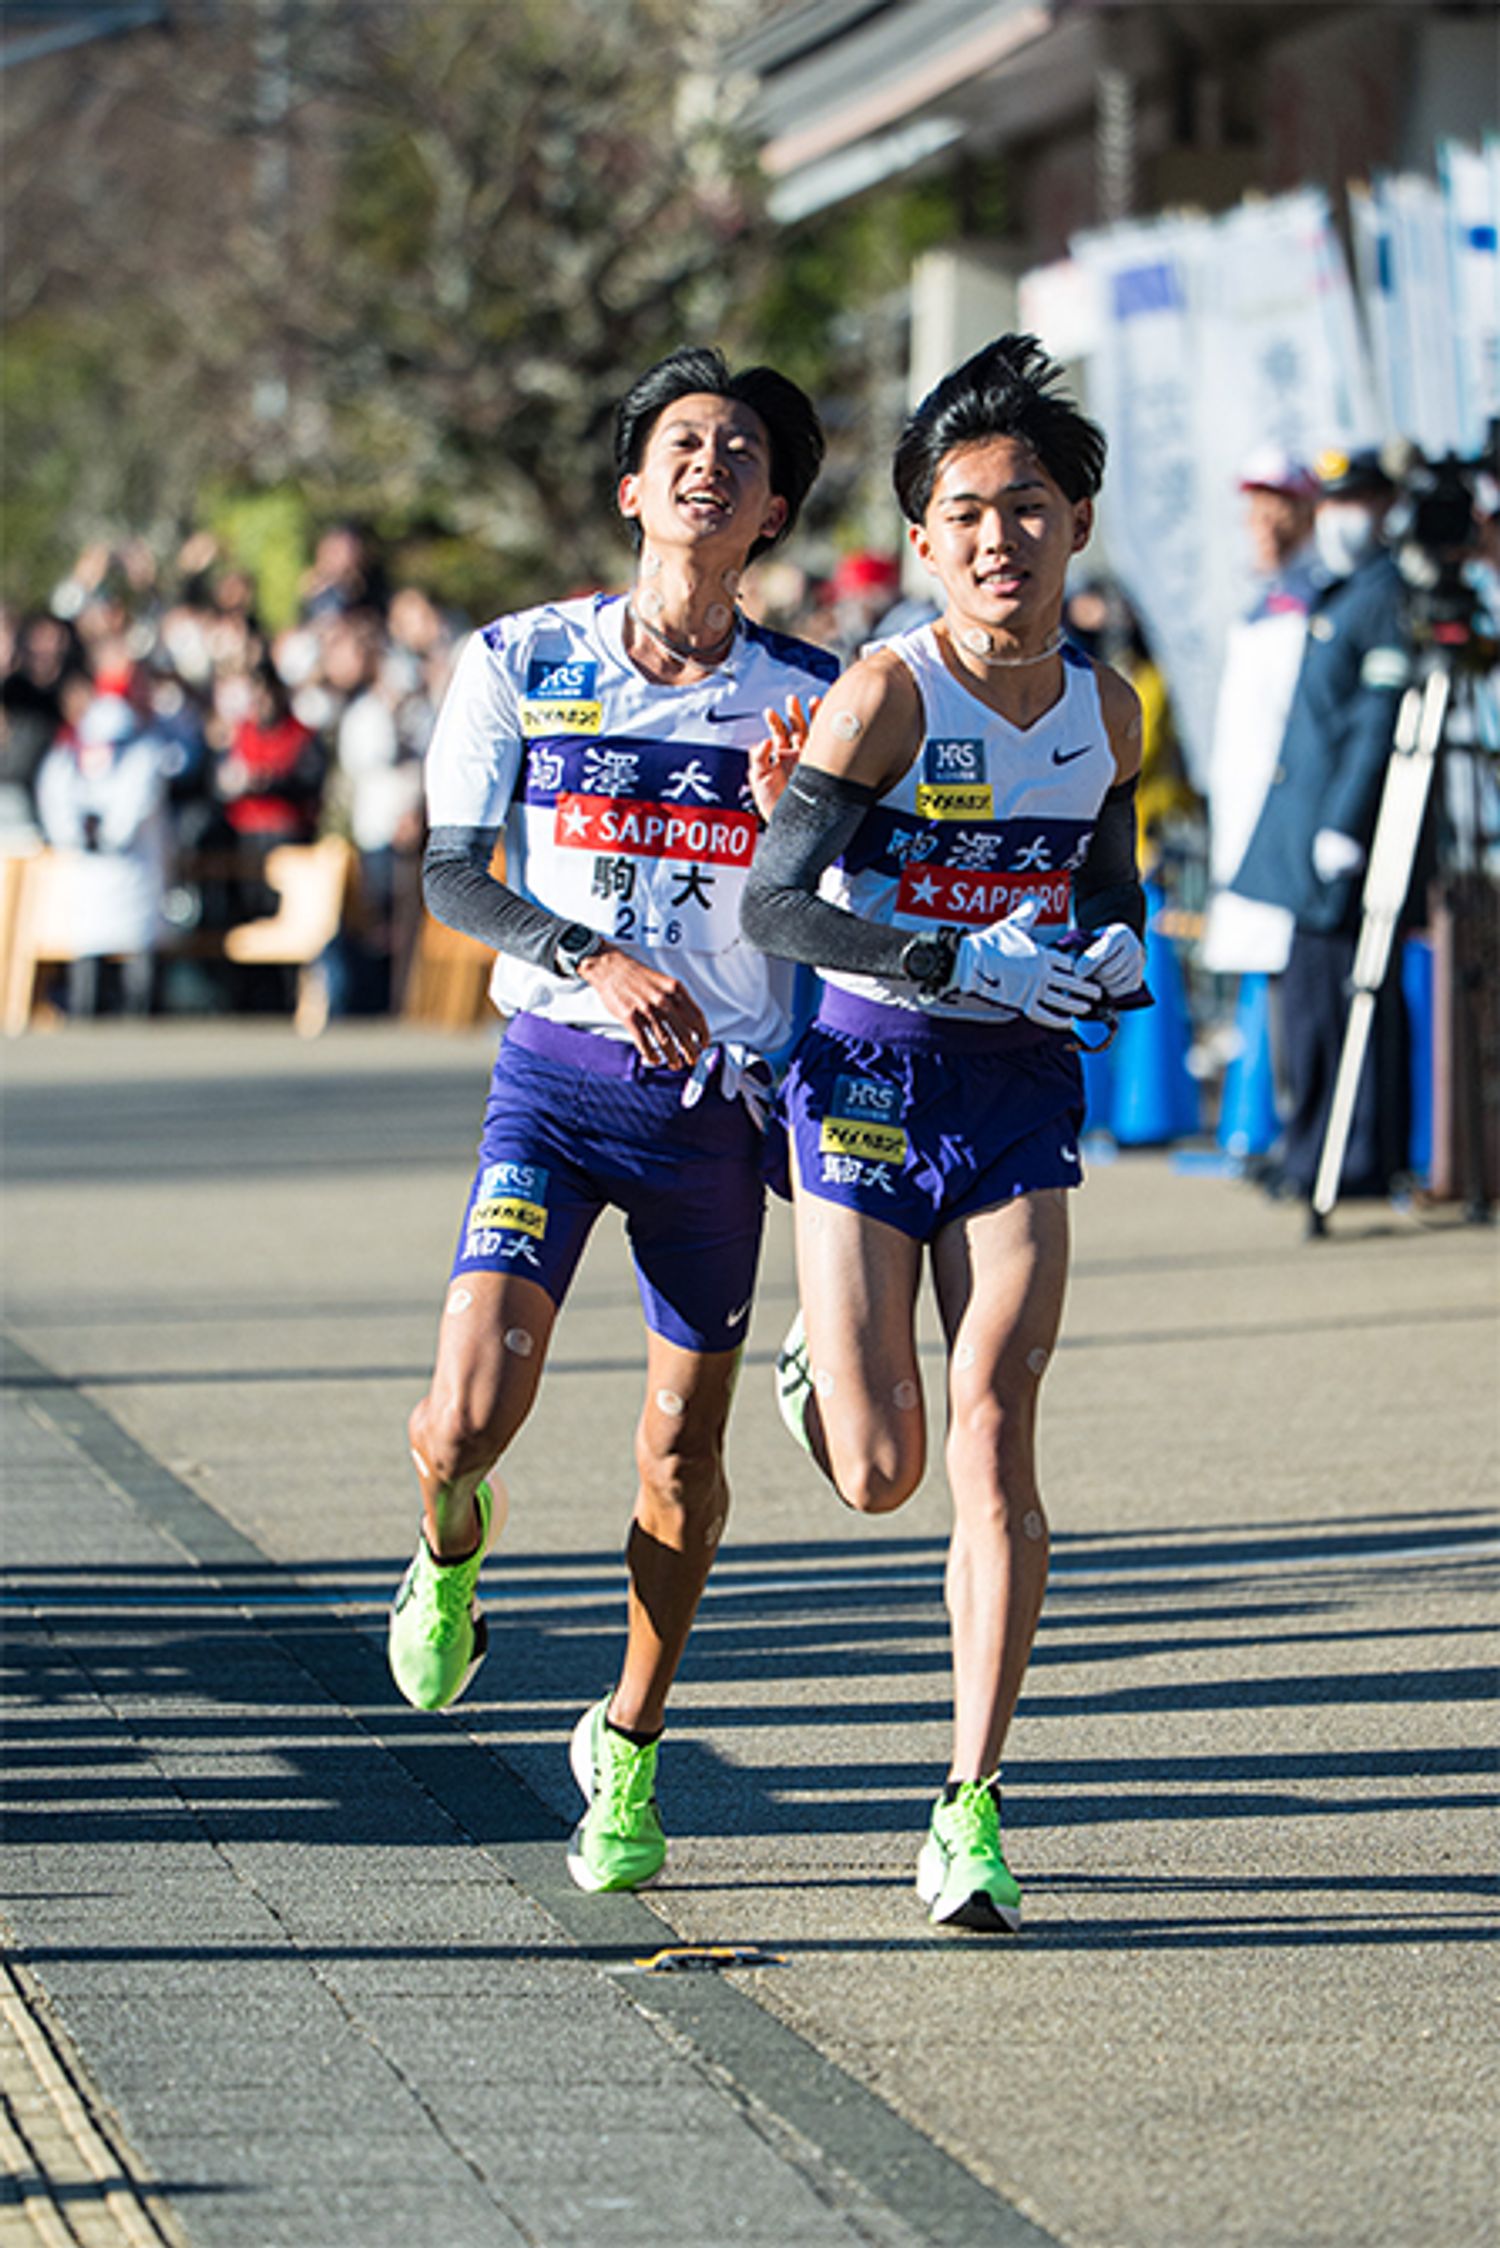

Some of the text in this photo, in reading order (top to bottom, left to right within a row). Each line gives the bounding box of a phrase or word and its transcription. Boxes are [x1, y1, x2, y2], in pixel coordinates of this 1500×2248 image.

[936, 742, 976, 769] HRS
[527, 747, 755, 813] 駒澤大
[598, 811, 751, 857] SAPPORO
[591, 856, 716, 911] 駒大
[613, 907, 684, 944] 2-6
[847, 1081, 895, 1109] HRS
